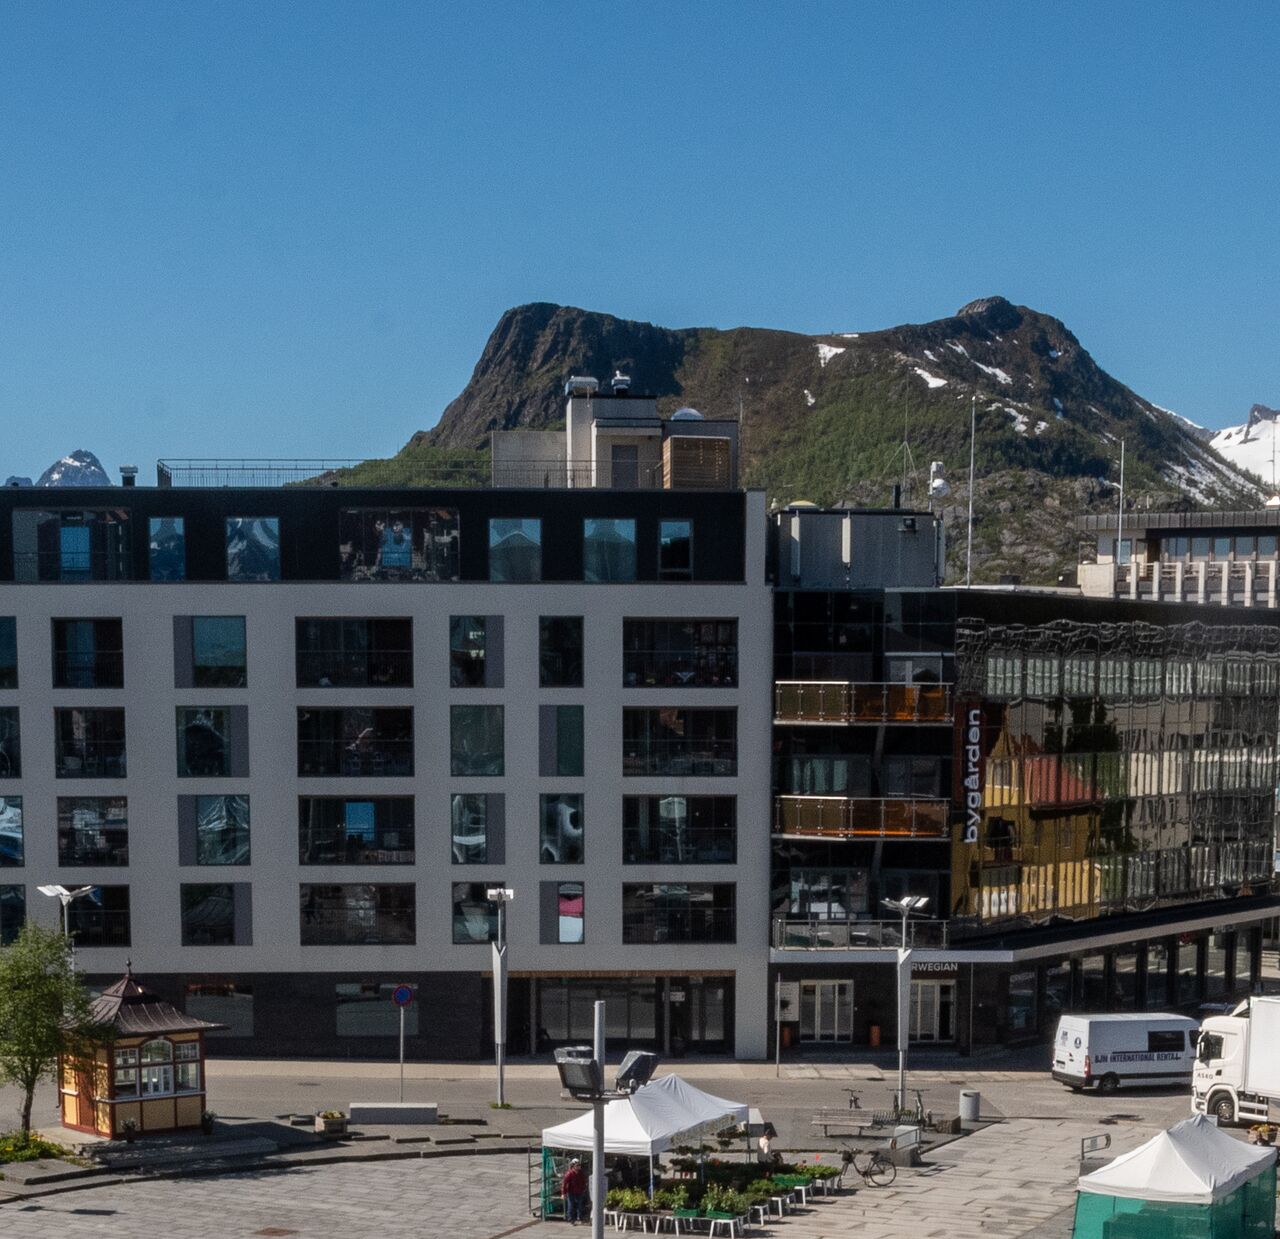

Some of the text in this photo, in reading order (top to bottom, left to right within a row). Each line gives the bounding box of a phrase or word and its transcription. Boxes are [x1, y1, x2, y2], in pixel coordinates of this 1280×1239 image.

[964, 709, 981, 843] bygården
[911, 962, 959, 972] RWEGIAN
[1110, 1053, 1155, 1062] INTERNATIONAL
